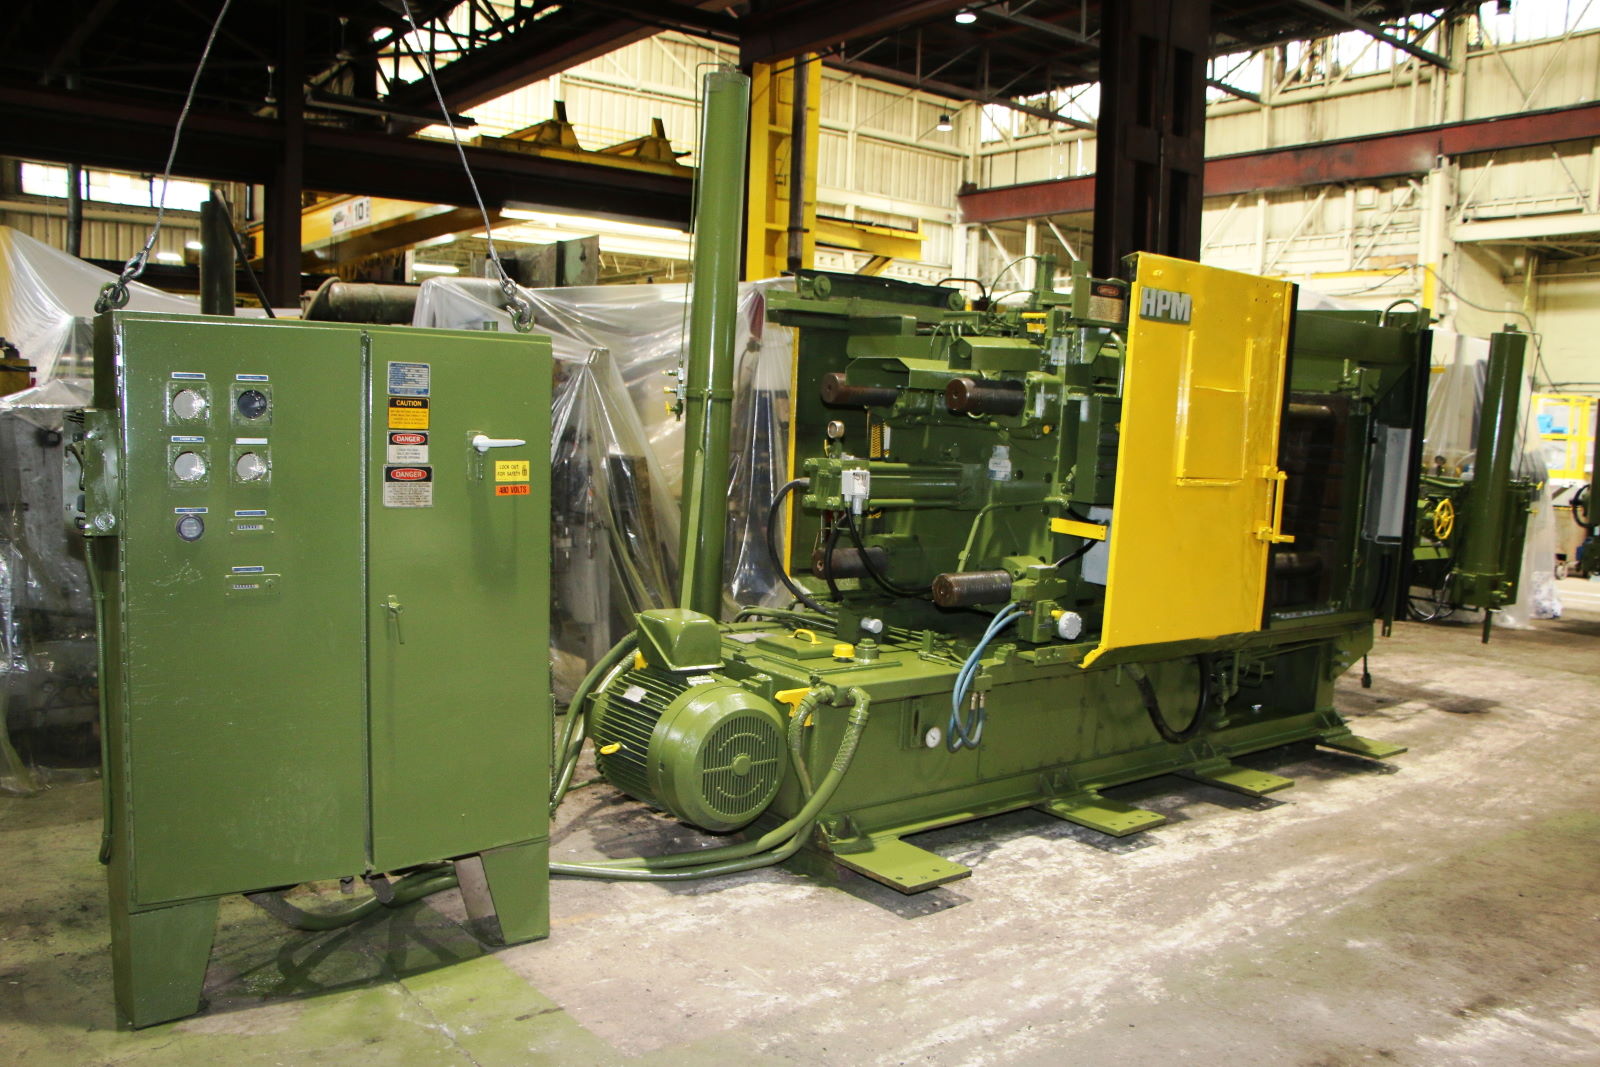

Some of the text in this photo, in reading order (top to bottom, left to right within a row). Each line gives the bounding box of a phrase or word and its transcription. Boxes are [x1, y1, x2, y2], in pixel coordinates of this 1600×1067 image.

[354, 202, 364, 222] 10
[1142, 287, 1191, 322] HPM
[396, 399, 422, 407] CAUTION
